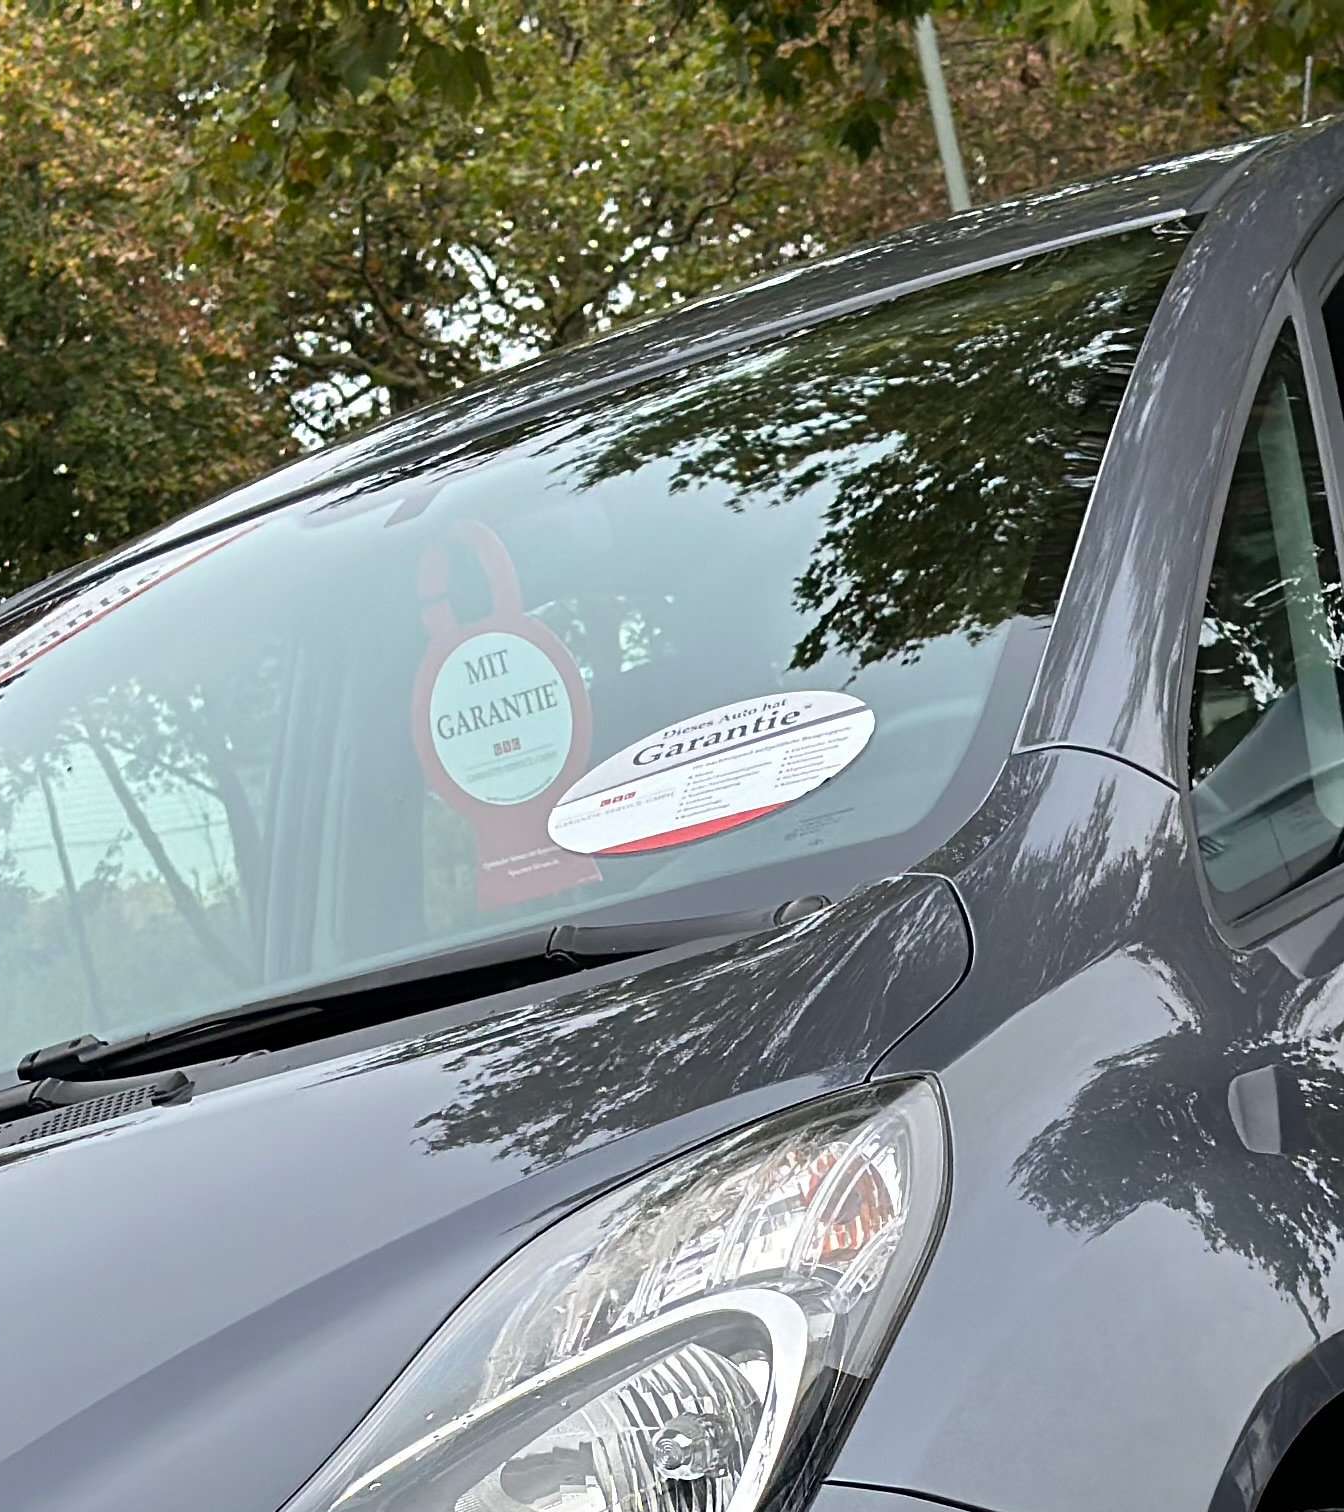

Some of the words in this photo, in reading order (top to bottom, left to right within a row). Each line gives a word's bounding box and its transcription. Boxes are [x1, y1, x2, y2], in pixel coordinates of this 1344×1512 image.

[463, 650, 509, 686] MIT
[662, 717, 715, 740] Dieses
[718, 705, 759, 724] Auto
[761, 697, 787, 715] hat
